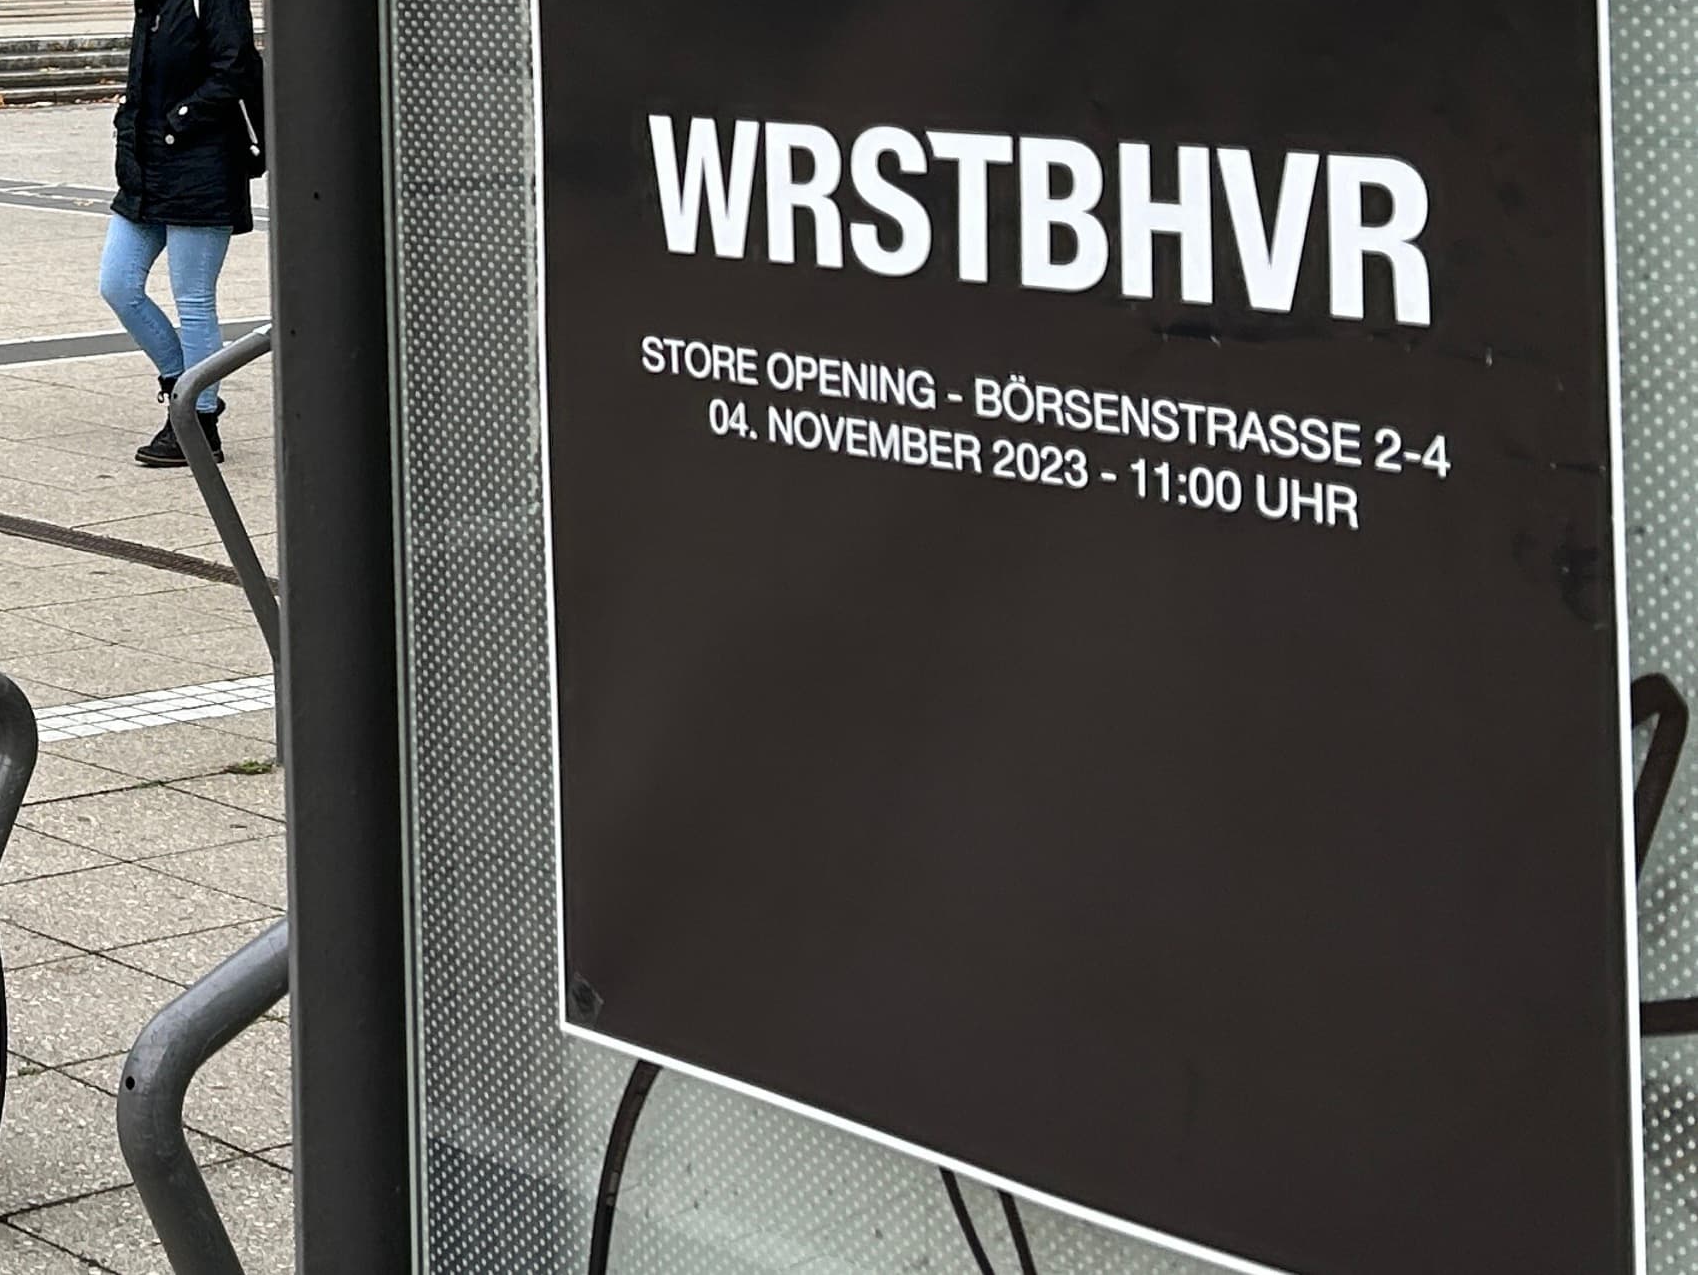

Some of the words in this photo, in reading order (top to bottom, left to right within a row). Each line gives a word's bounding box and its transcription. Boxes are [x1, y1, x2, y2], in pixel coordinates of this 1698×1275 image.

[647, 114, 1432, 326] WRSTBHVR
[640, 334, 760, 387] STORE
[766, 350, 937, 411] OPENING
[974, 373, 1363, 467] BÖRSENSTRASSE
[1374, 426, 1452, 478] 2-4
[708, 398, 759, 441] 04.
[768, 404, 983, 474] NOVEMBER
[992, 438, 1090, 489] 2023
[1130, 457, 1242, 513] 11:00
[1256, 472, 1360, 530] UHR
